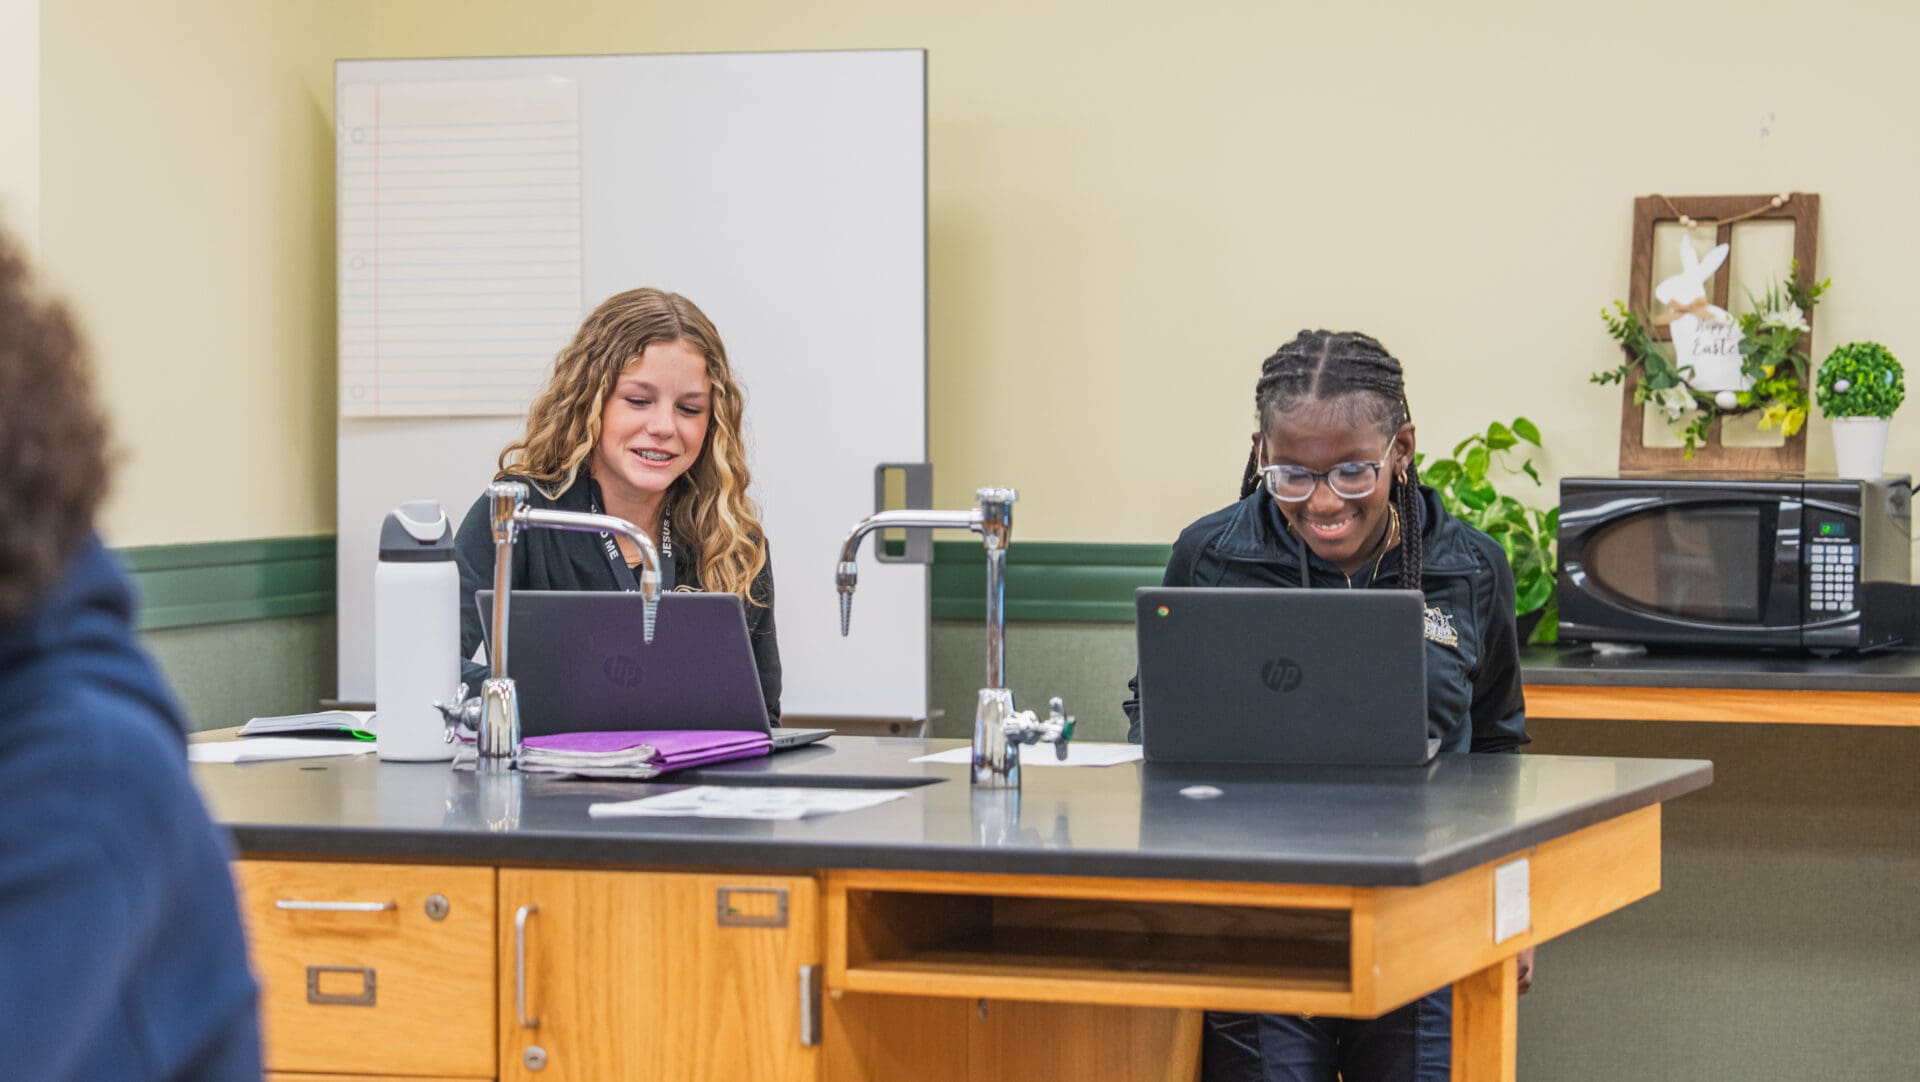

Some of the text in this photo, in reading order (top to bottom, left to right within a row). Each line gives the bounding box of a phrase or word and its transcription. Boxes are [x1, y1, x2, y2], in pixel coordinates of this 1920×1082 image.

[1692, 337, 1736, 355] Easte
[604, 539, 619, 560] ME
[662, 519, 672, 557] JESUS
[1264, 657, 1300, 693] hp
